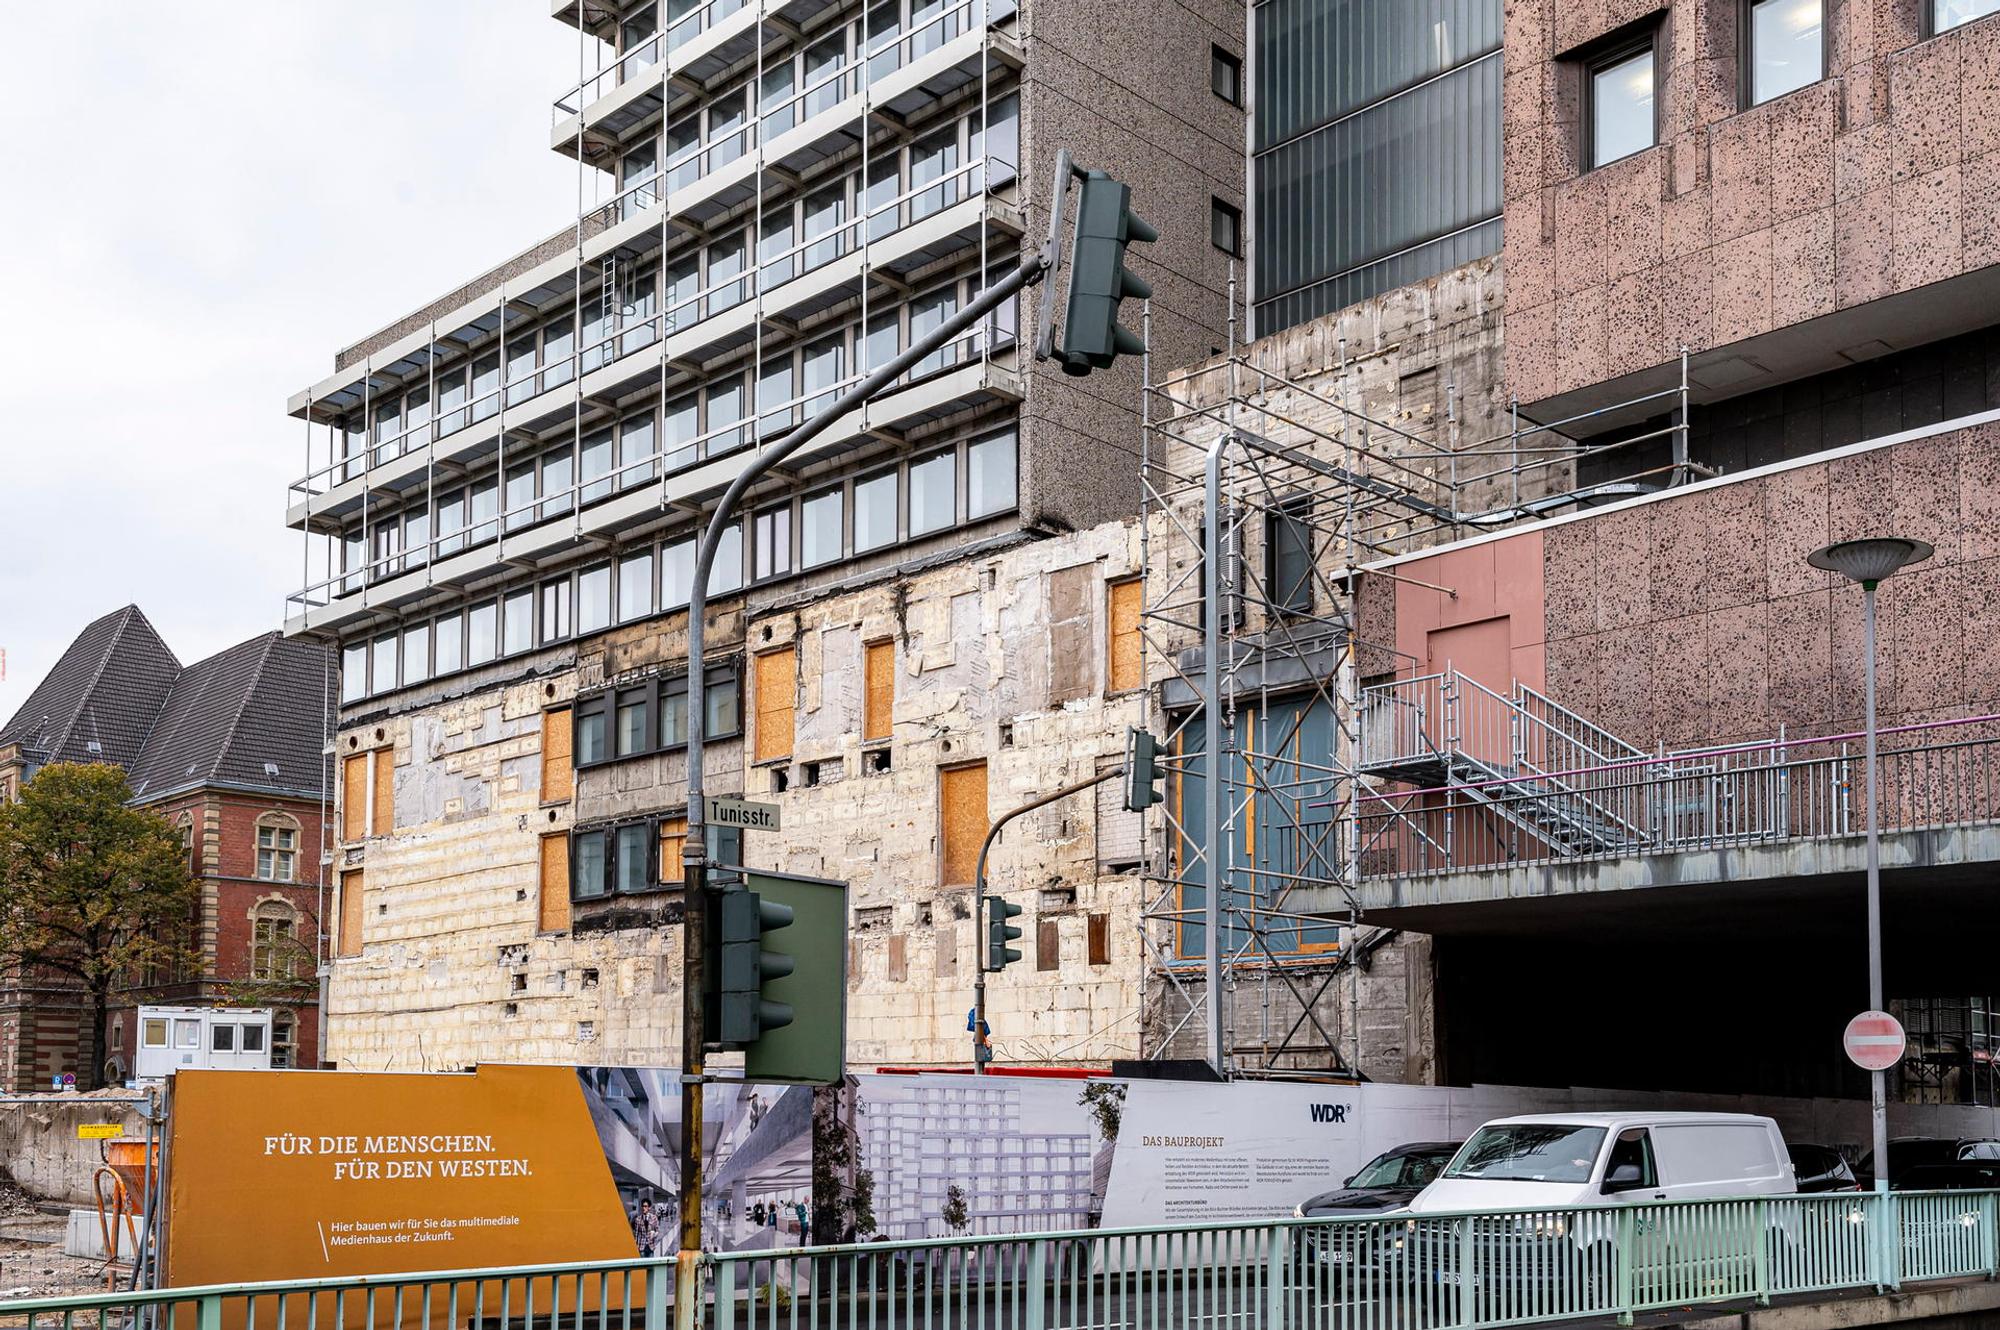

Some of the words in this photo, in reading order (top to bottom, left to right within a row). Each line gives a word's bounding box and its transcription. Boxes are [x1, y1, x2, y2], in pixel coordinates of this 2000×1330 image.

[711, 801, 774, 827] Tunisstr.
[1310, 1103, 1346, 1123] WDR
[264, 1132, 313, 1156] FÜR
[318, 1136, 358, 1155] DIE
[363, 1135, 496, 1155] MENSCHEN.
[1142, 1136, 1162, 1147] DAS
[1164, 1136, 1225, 1150] BAUPROJEKT
[334, 1157, 381, 1180] FÜR
[386, 1160, 433, 1179] DEN
[438, 1159, 533, 1178] WESTEN.
[331, 1221, 354, 1232] Hier
[356, 1220, 387, 1231] bauen
[389, 1219, 406, 1230] wir
[407, 1218, 422, 1229] für
[424, 1218, 438, 1228] Sie
[440, 1217, 457, 1228] das
[459, 1215, 520, 1227] multimediale
[330, 1233, 393, 1246] Medienhaus
[394, 1232, 411, 1243] der
[413, 1230, 455, 1243] Zukunft.
